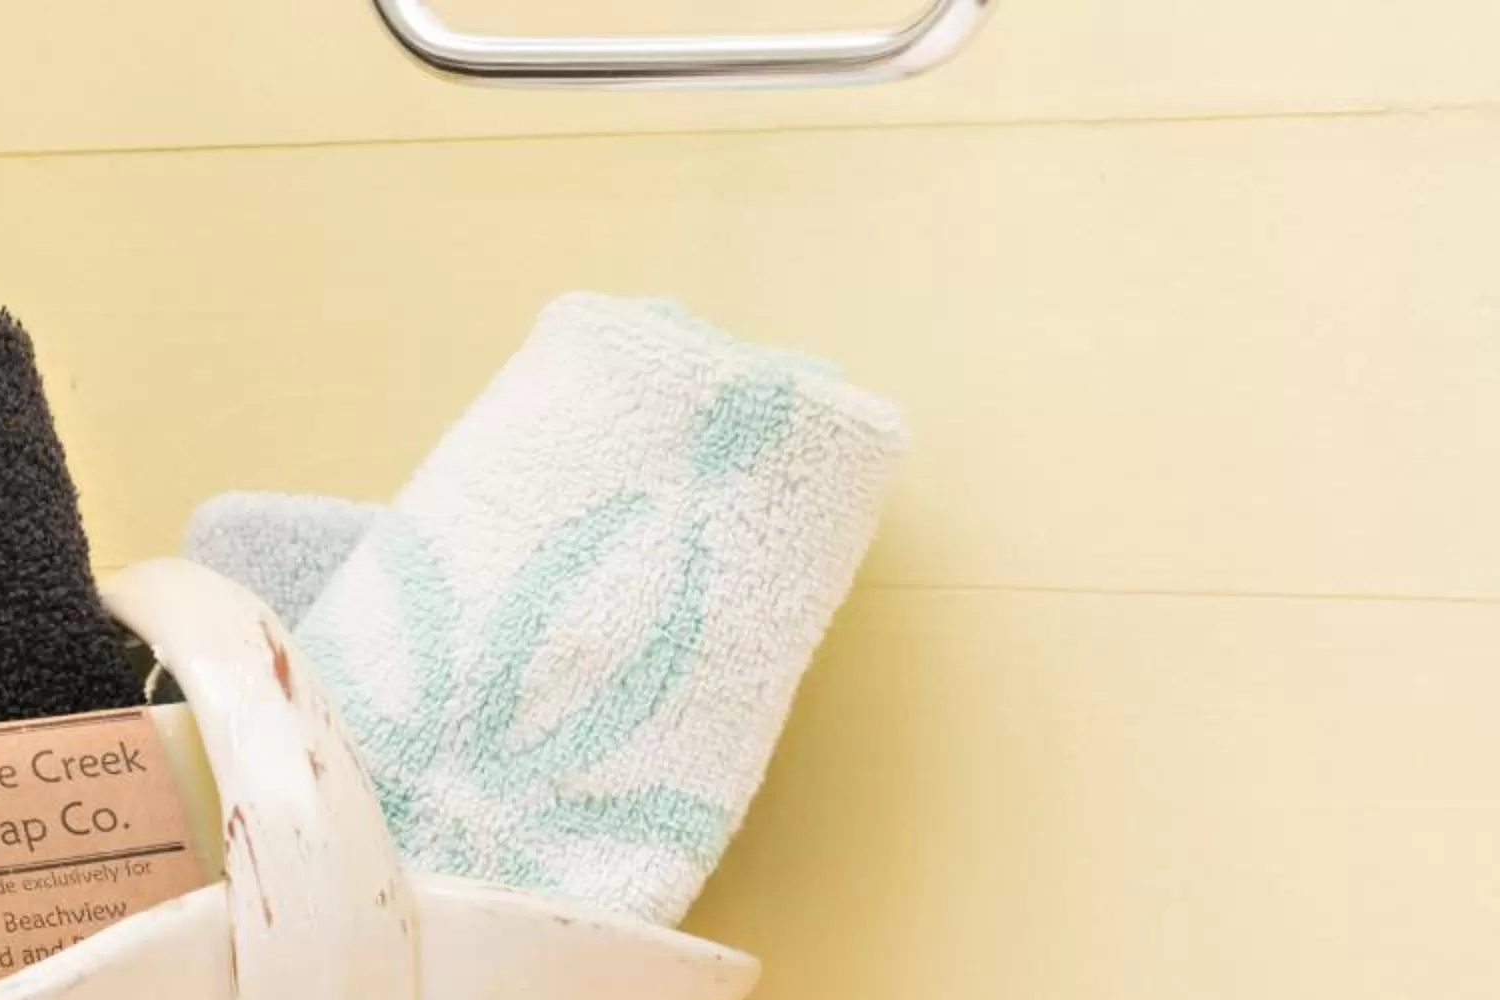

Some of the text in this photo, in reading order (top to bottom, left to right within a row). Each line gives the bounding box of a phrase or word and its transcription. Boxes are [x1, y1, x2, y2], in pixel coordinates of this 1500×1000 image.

[32, 741, 147, 785] Creek
[60, 801, 132, 837] Co.
[23, 865, 119, 891] exclusively
[125, 859, 154, 877] for
[3, 901, 128, 933] Beachview
